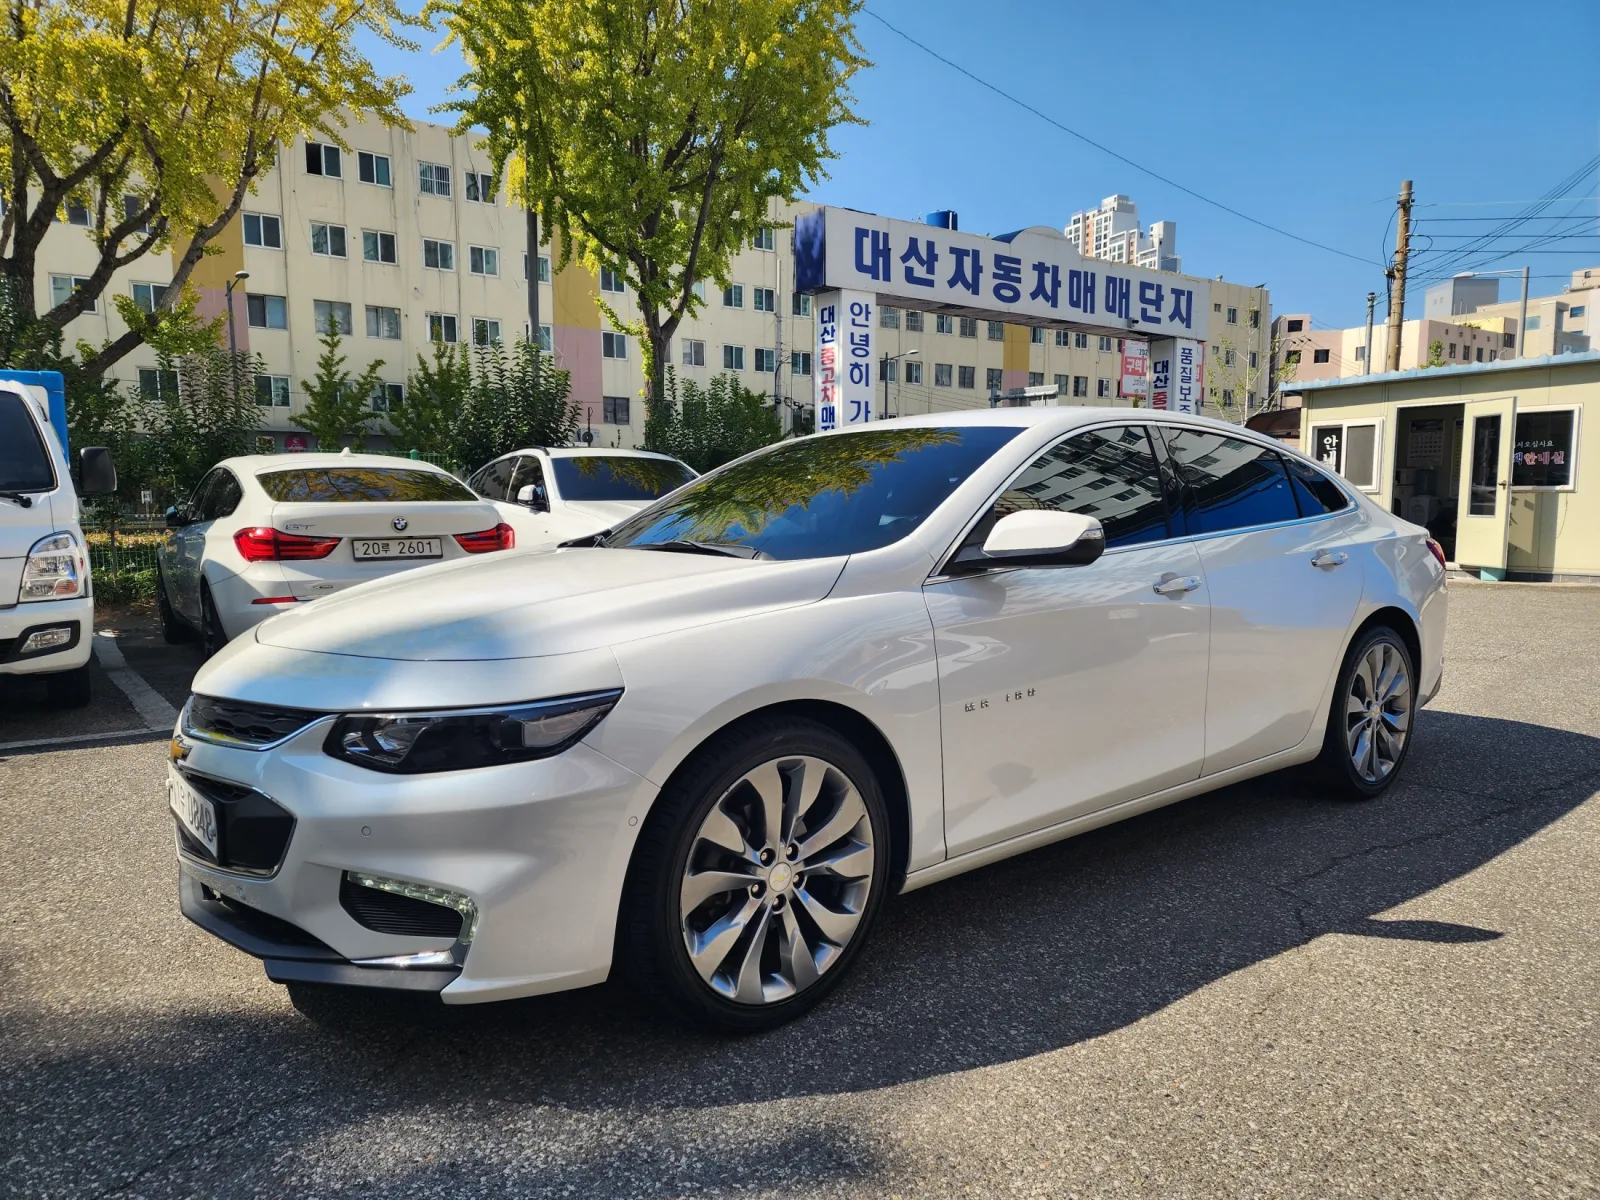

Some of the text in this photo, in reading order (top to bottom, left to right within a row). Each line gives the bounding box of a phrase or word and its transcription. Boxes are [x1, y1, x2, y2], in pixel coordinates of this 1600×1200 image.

[853, 226, 1193, 329] 대산자동차매매단지
[849, 302, 872, 387] 안녕히
[362, 541, 433, 556] 20루 2601
